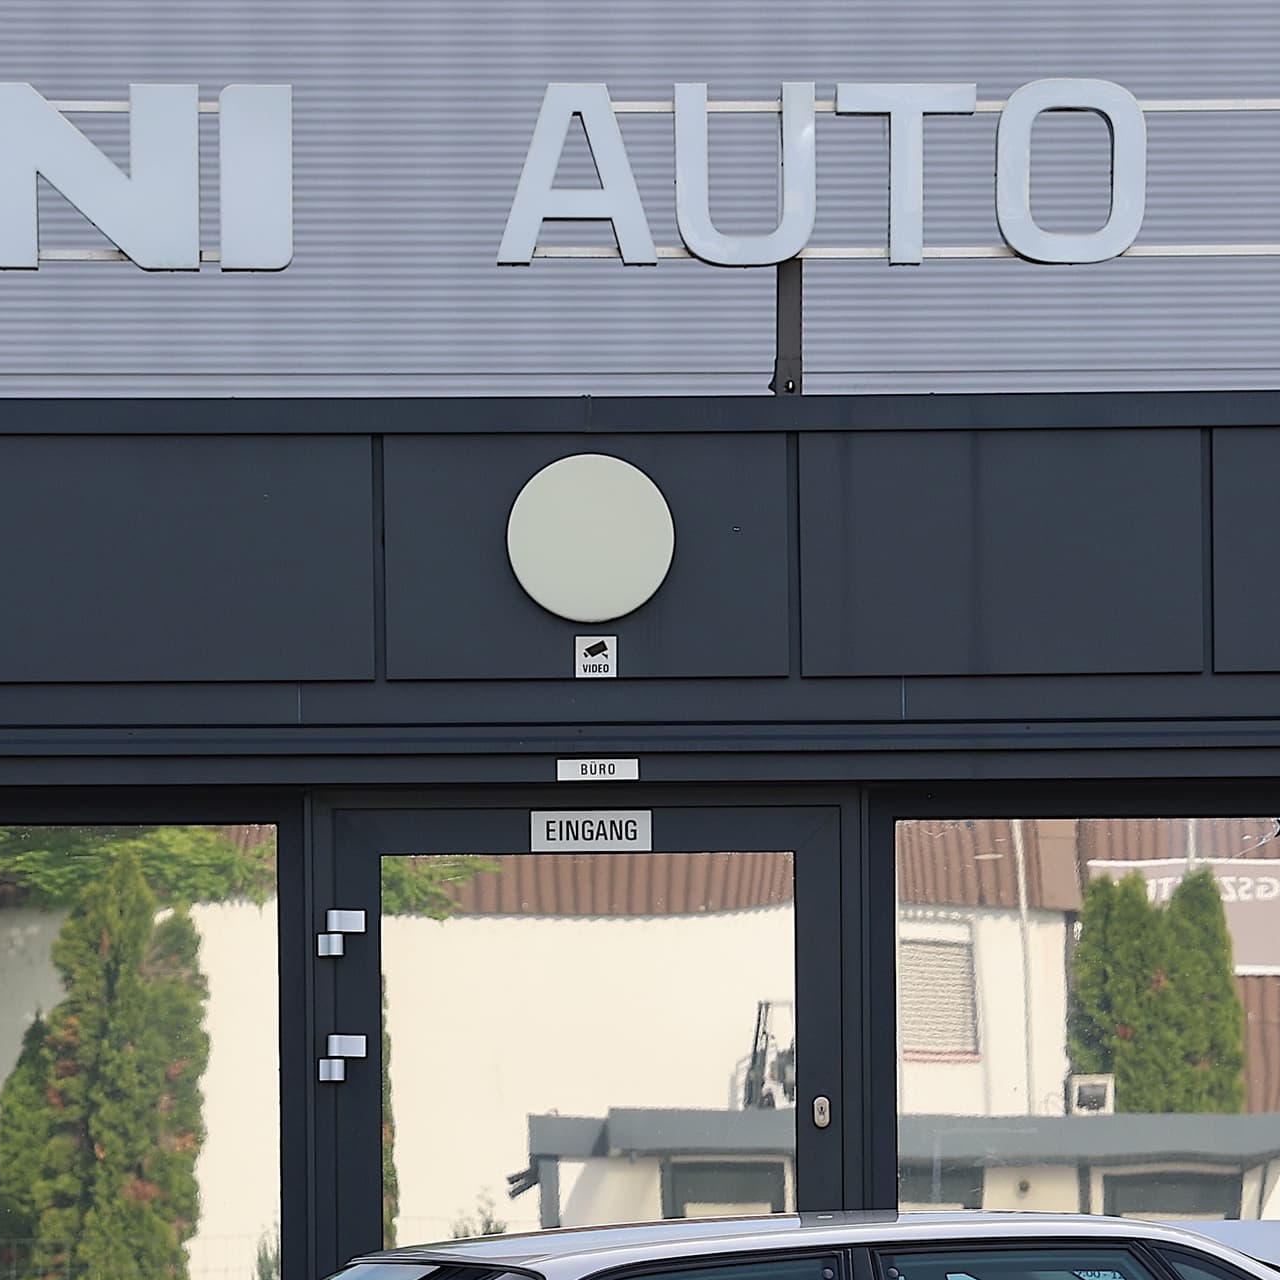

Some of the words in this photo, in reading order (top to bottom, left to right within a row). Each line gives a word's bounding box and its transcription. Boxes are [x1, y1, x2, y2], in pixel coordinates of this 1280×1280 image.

[497, 77, 1148, 267] AUTO
[582, 663, 610, 674] VIDEO
[580, 760, 616, 776] BÜRO
[545, 819, 638, 841] EINGANG
